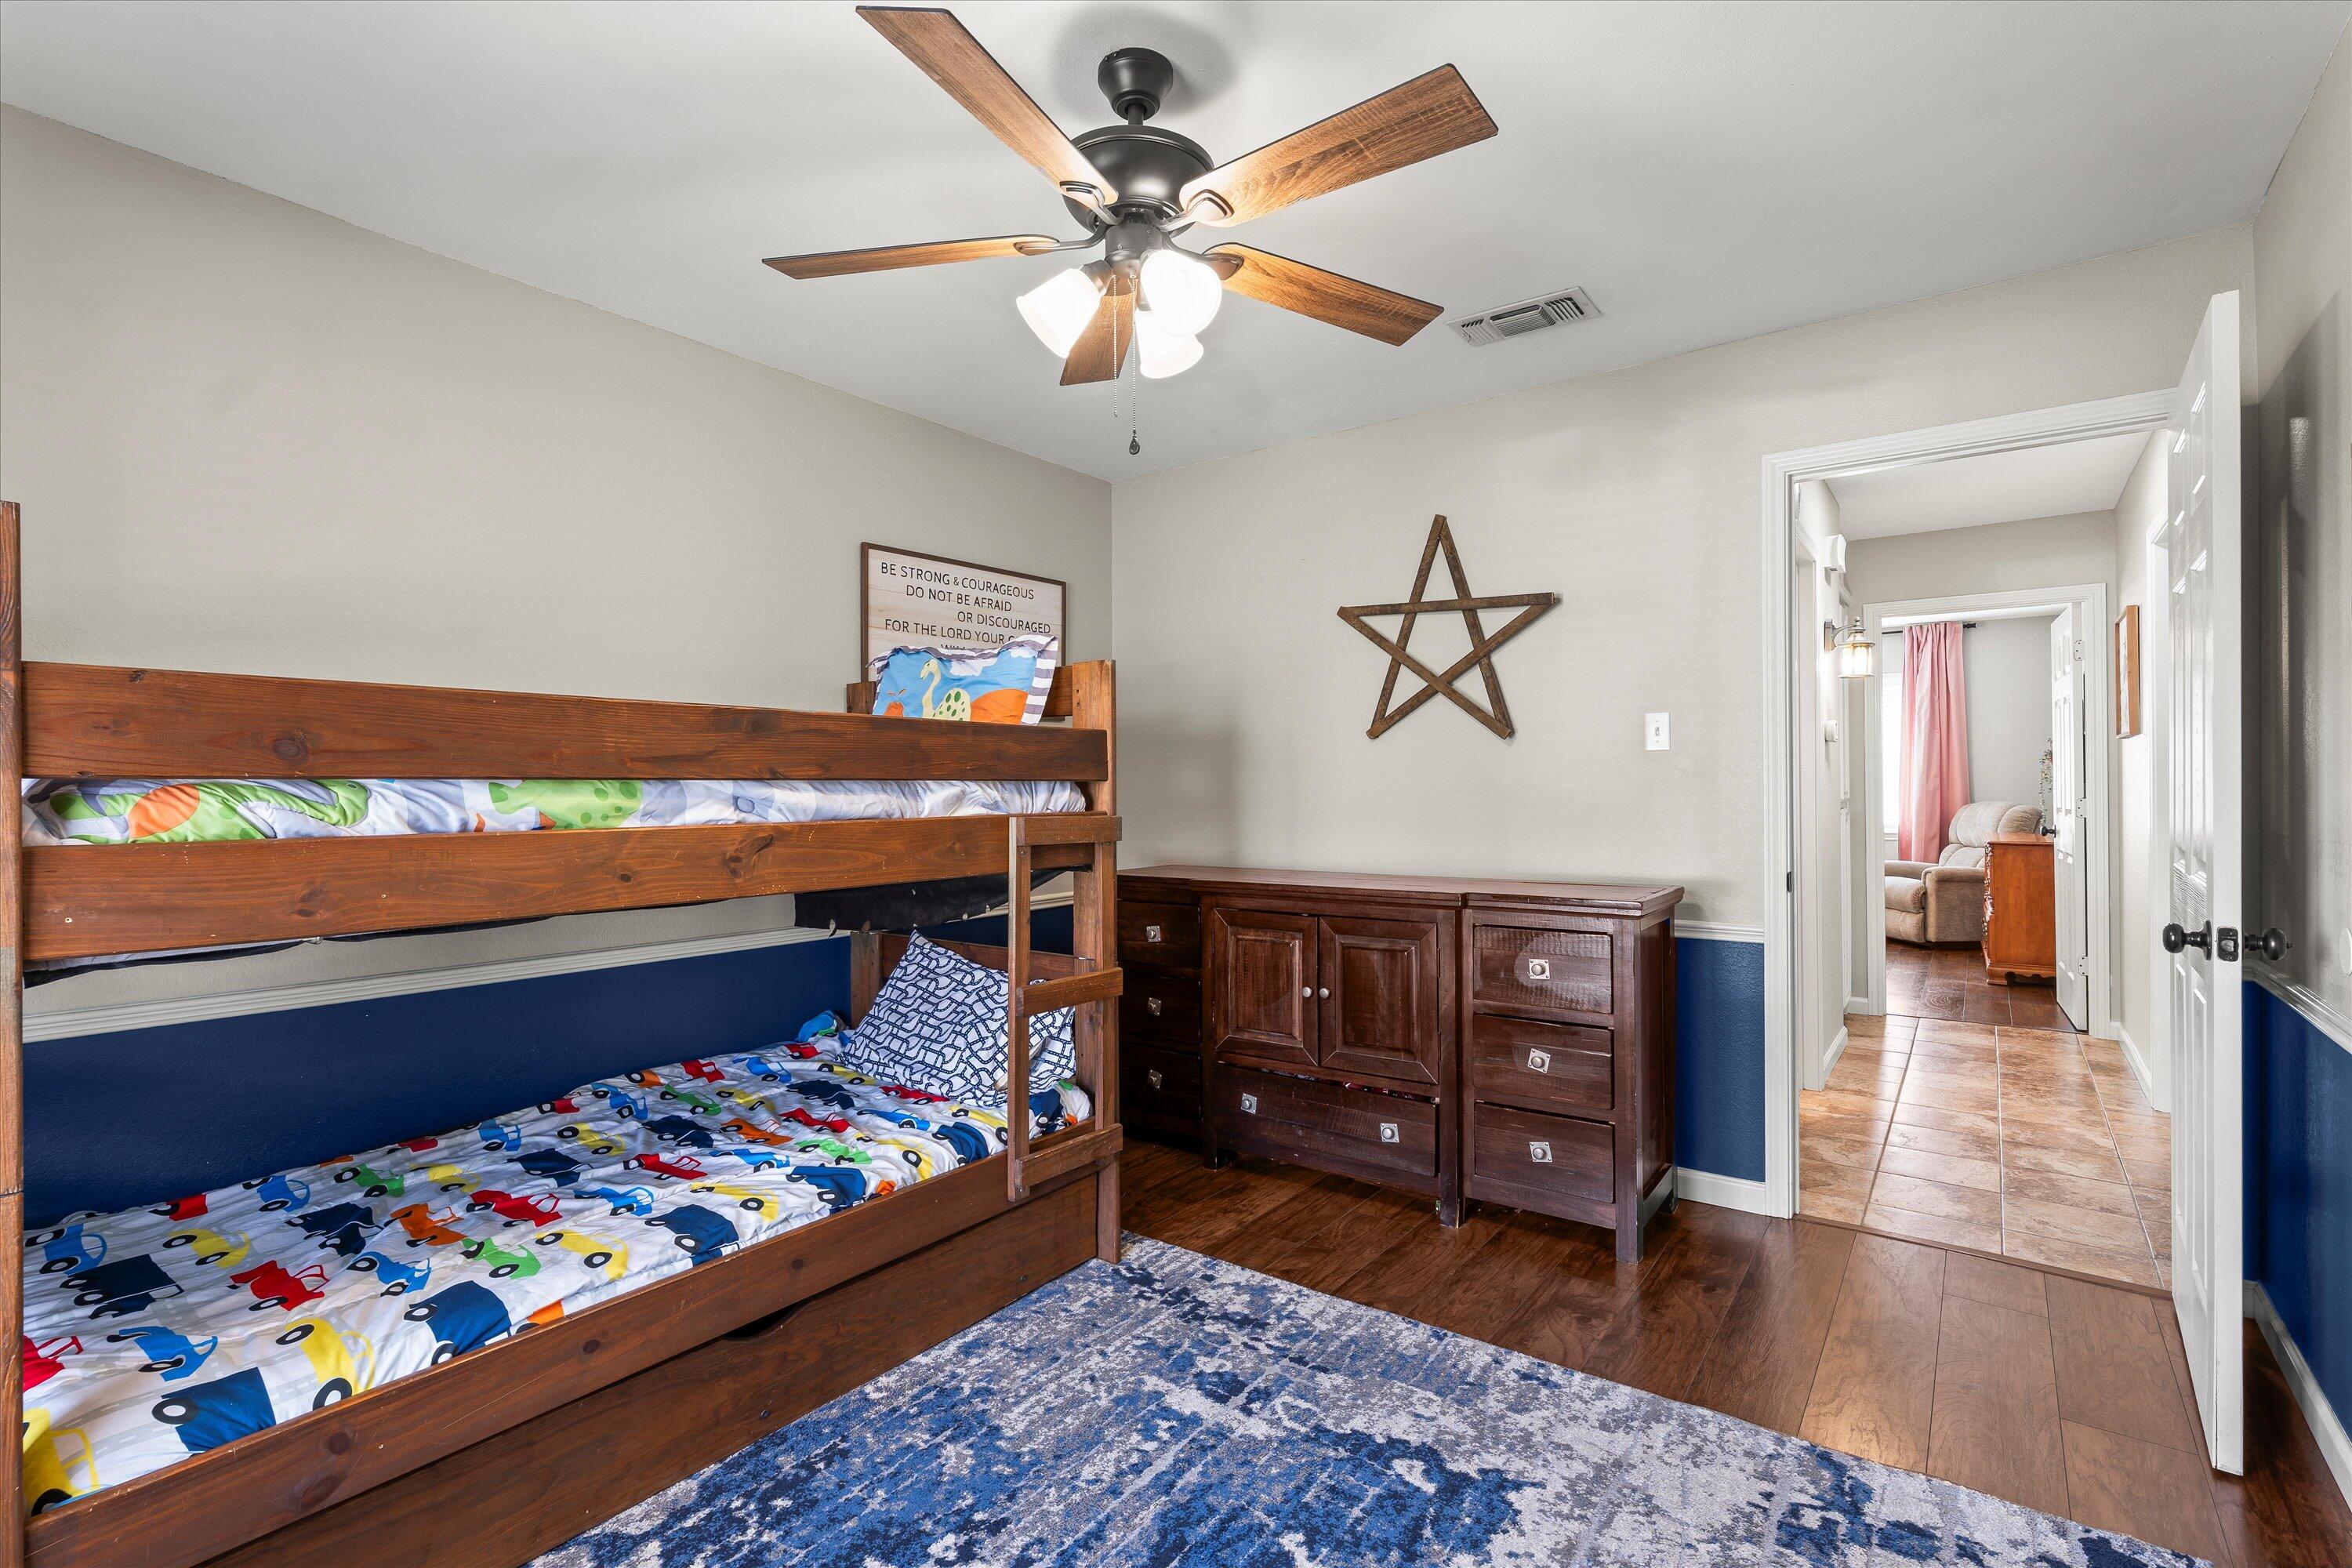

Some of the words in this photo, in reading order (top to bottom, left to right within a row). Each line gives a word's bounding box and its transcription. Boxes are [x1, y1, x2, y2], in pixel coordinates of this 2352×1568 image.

[881, 562, 896, 575] BE
[901, 566, 949, 585] STRONG
[953, 576, 960, 586] &
[962, 577, 1034, 599] COURAGEOUS
[906, 585, 924, 597] DO
[929, 588, 953, 602] NOT
[956, 593, 970, 605] BE
[974, 597, 1012, 612] AFRAID
[885, 619, 909, 633] FOR
[913, 622, 937, 637] THE
[941, 626, 971, 640] LORD
[975, 631, 1004, 644] YOUR
[957, 612, 972, 623] OR
[977, 614, 1051, 633] DISCOURAGED
